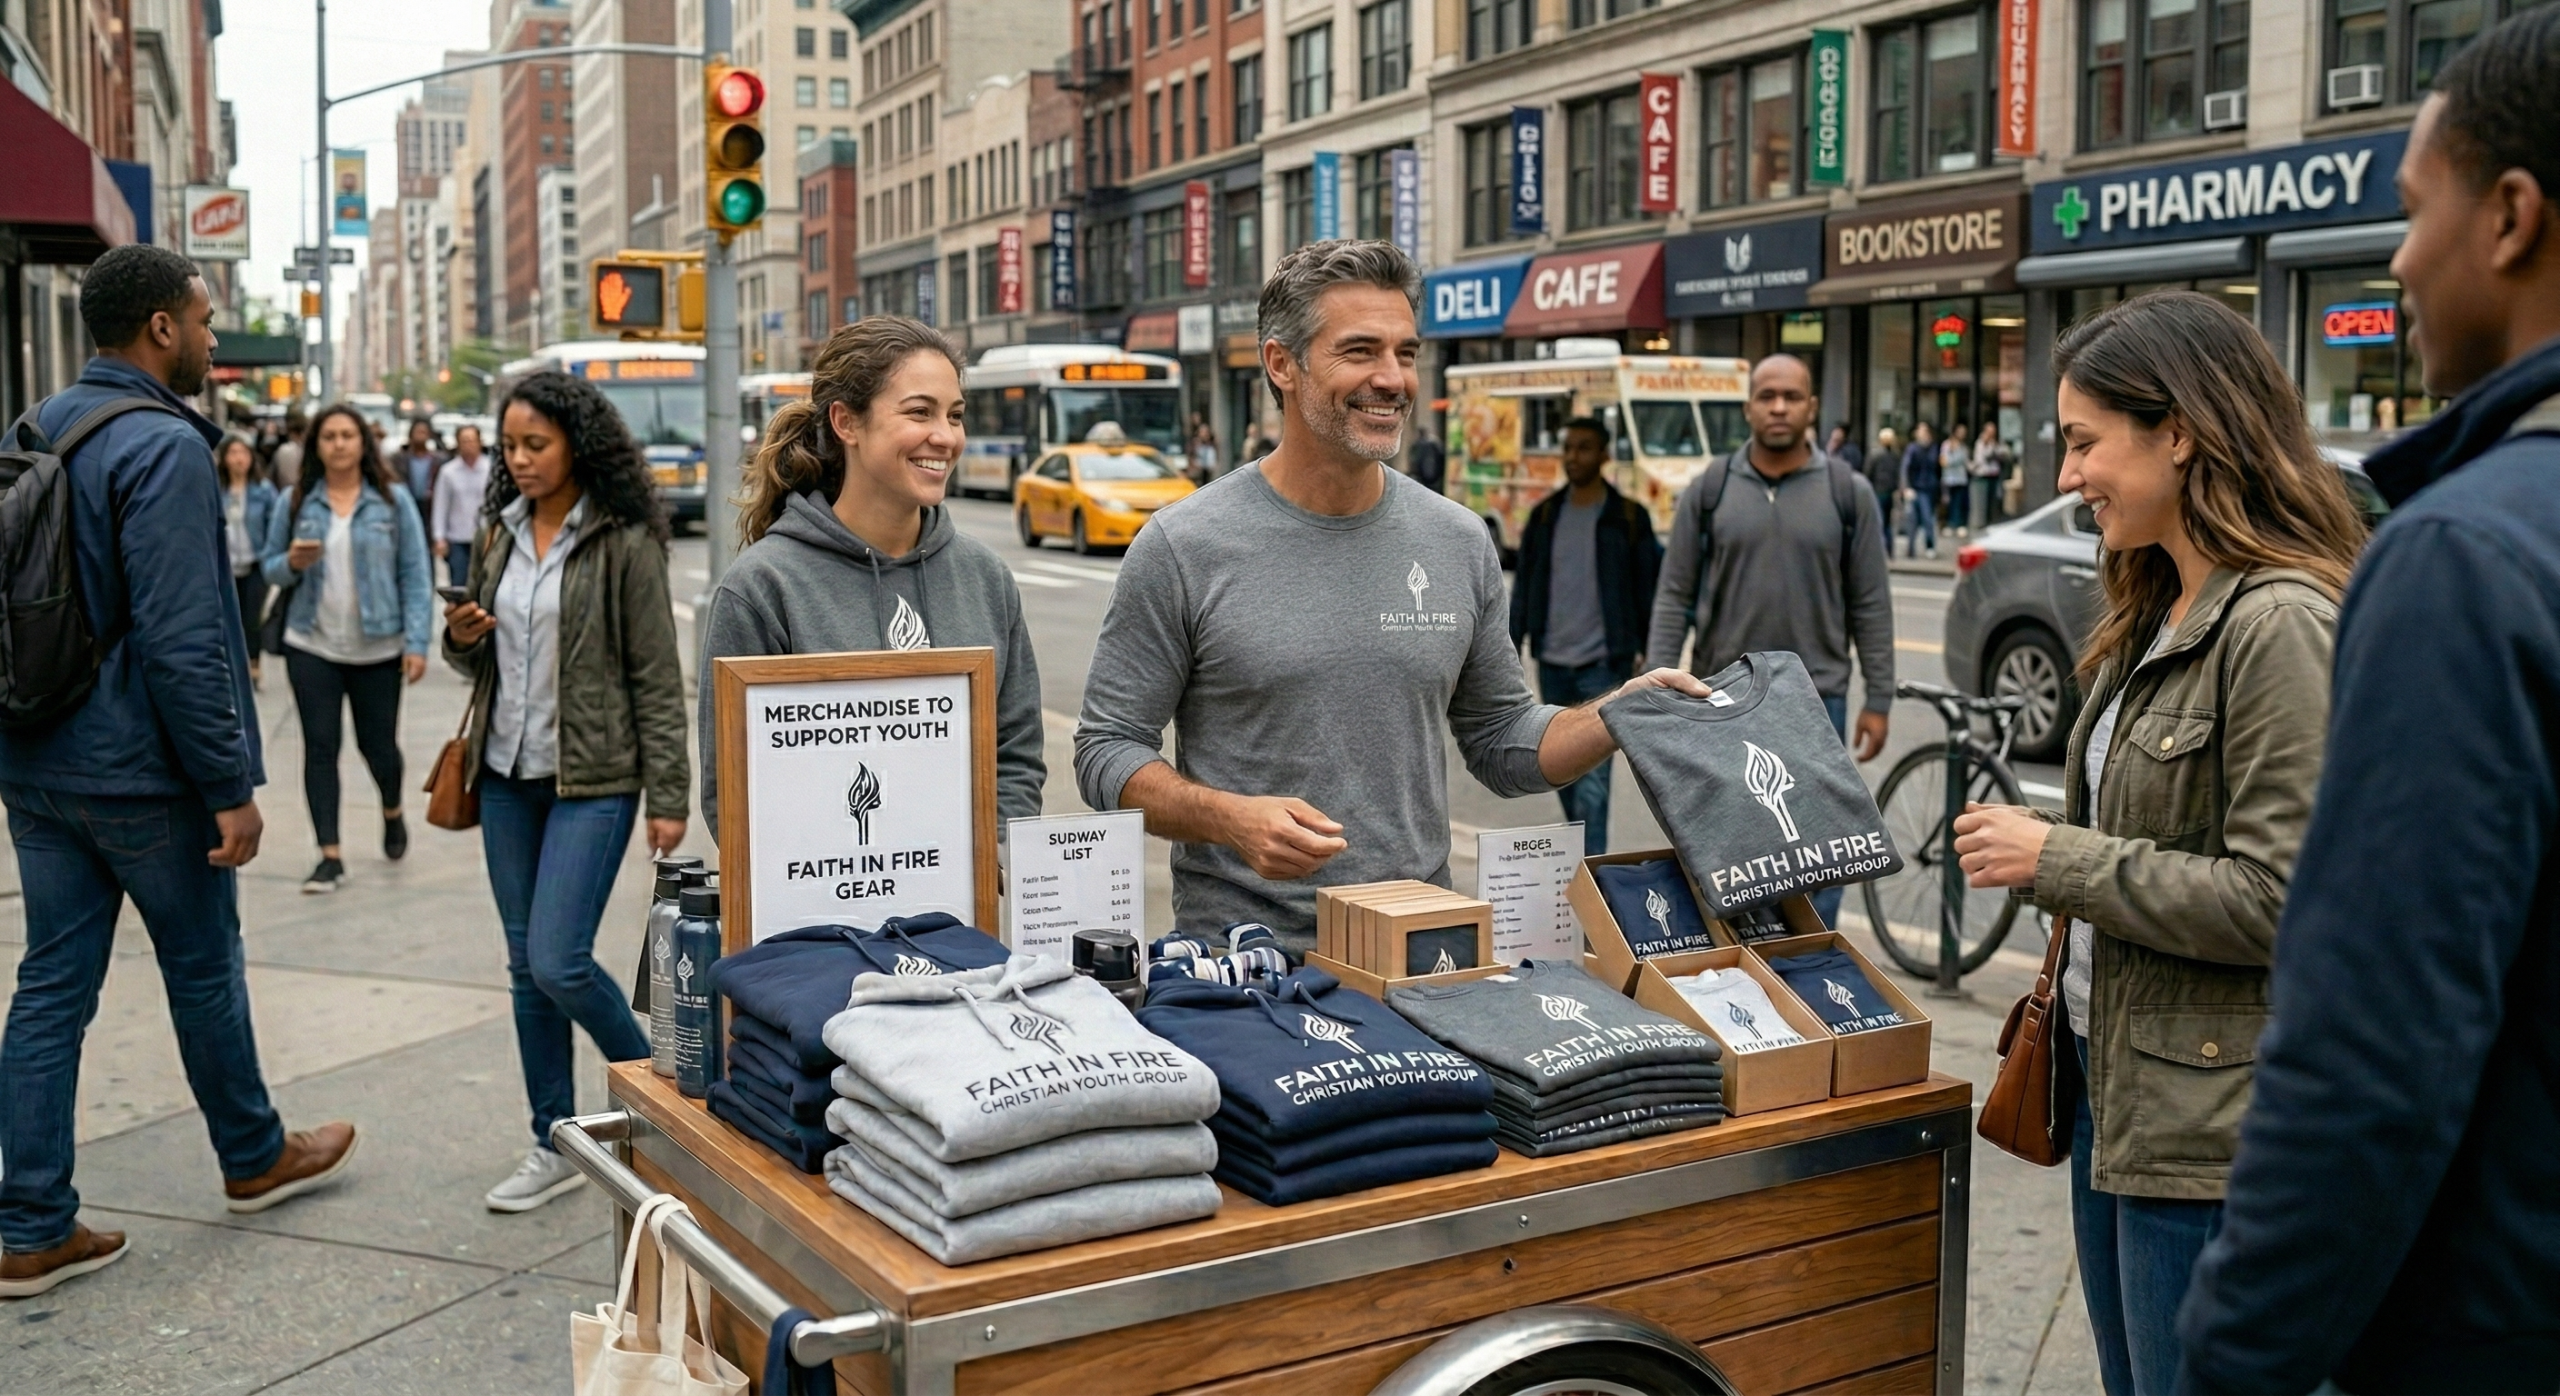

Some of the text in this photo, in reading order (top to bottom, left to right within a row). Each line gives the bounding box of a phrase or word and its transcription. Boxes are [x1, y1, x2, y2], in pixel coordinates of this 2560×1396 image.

[1647, 86, 1671, 201] CAFE
[2101, 149, 2372, 232] PHARMACY
[1839, 209, 2003, 265] BOOKSTORE
[1435, 277, 1500, 322] DELI
[1533, 261, 1621, 311] CAFE
[2324, 308, 2395, 337] OPEN
[1380, 613, 1457, 623] FAITH IN FIRE
[765, 696, 953, 723] MERCHANDISE TO
[771, 721, 948, 748] SUPPORT YOUTH
[788, 849, 940, 880] FAITH IN FIRE
[1063, 848, 1092, 860] LIST
[1711, 832, 1886, 892] FAITH IN FIRE
[836, 879, 895, 900] GEAR
[1721, 856, 1890, 907] CHRISTIAN YOUTH GROUP
[1635, 934, 1710, 954] FAITH IN FIRE
[1525, 1023, 1697, 1067] FAITH IN FIRE
[1542, 1047, 1614, 1077] CHRISTIAN
[1614, 1040, 1662, 1055] YOUTH
[965, 1051, 1183, 1101] FAITH IN FIRE
[981, 1071, 1187, 1114] CHRISTIAN YOUTH GROUP
[1274, 1051, 1469, 1094] FAITH IN FIRE
[1293, 1069, 1478, 1105] CHRISTIAN YOUTH GROUP
